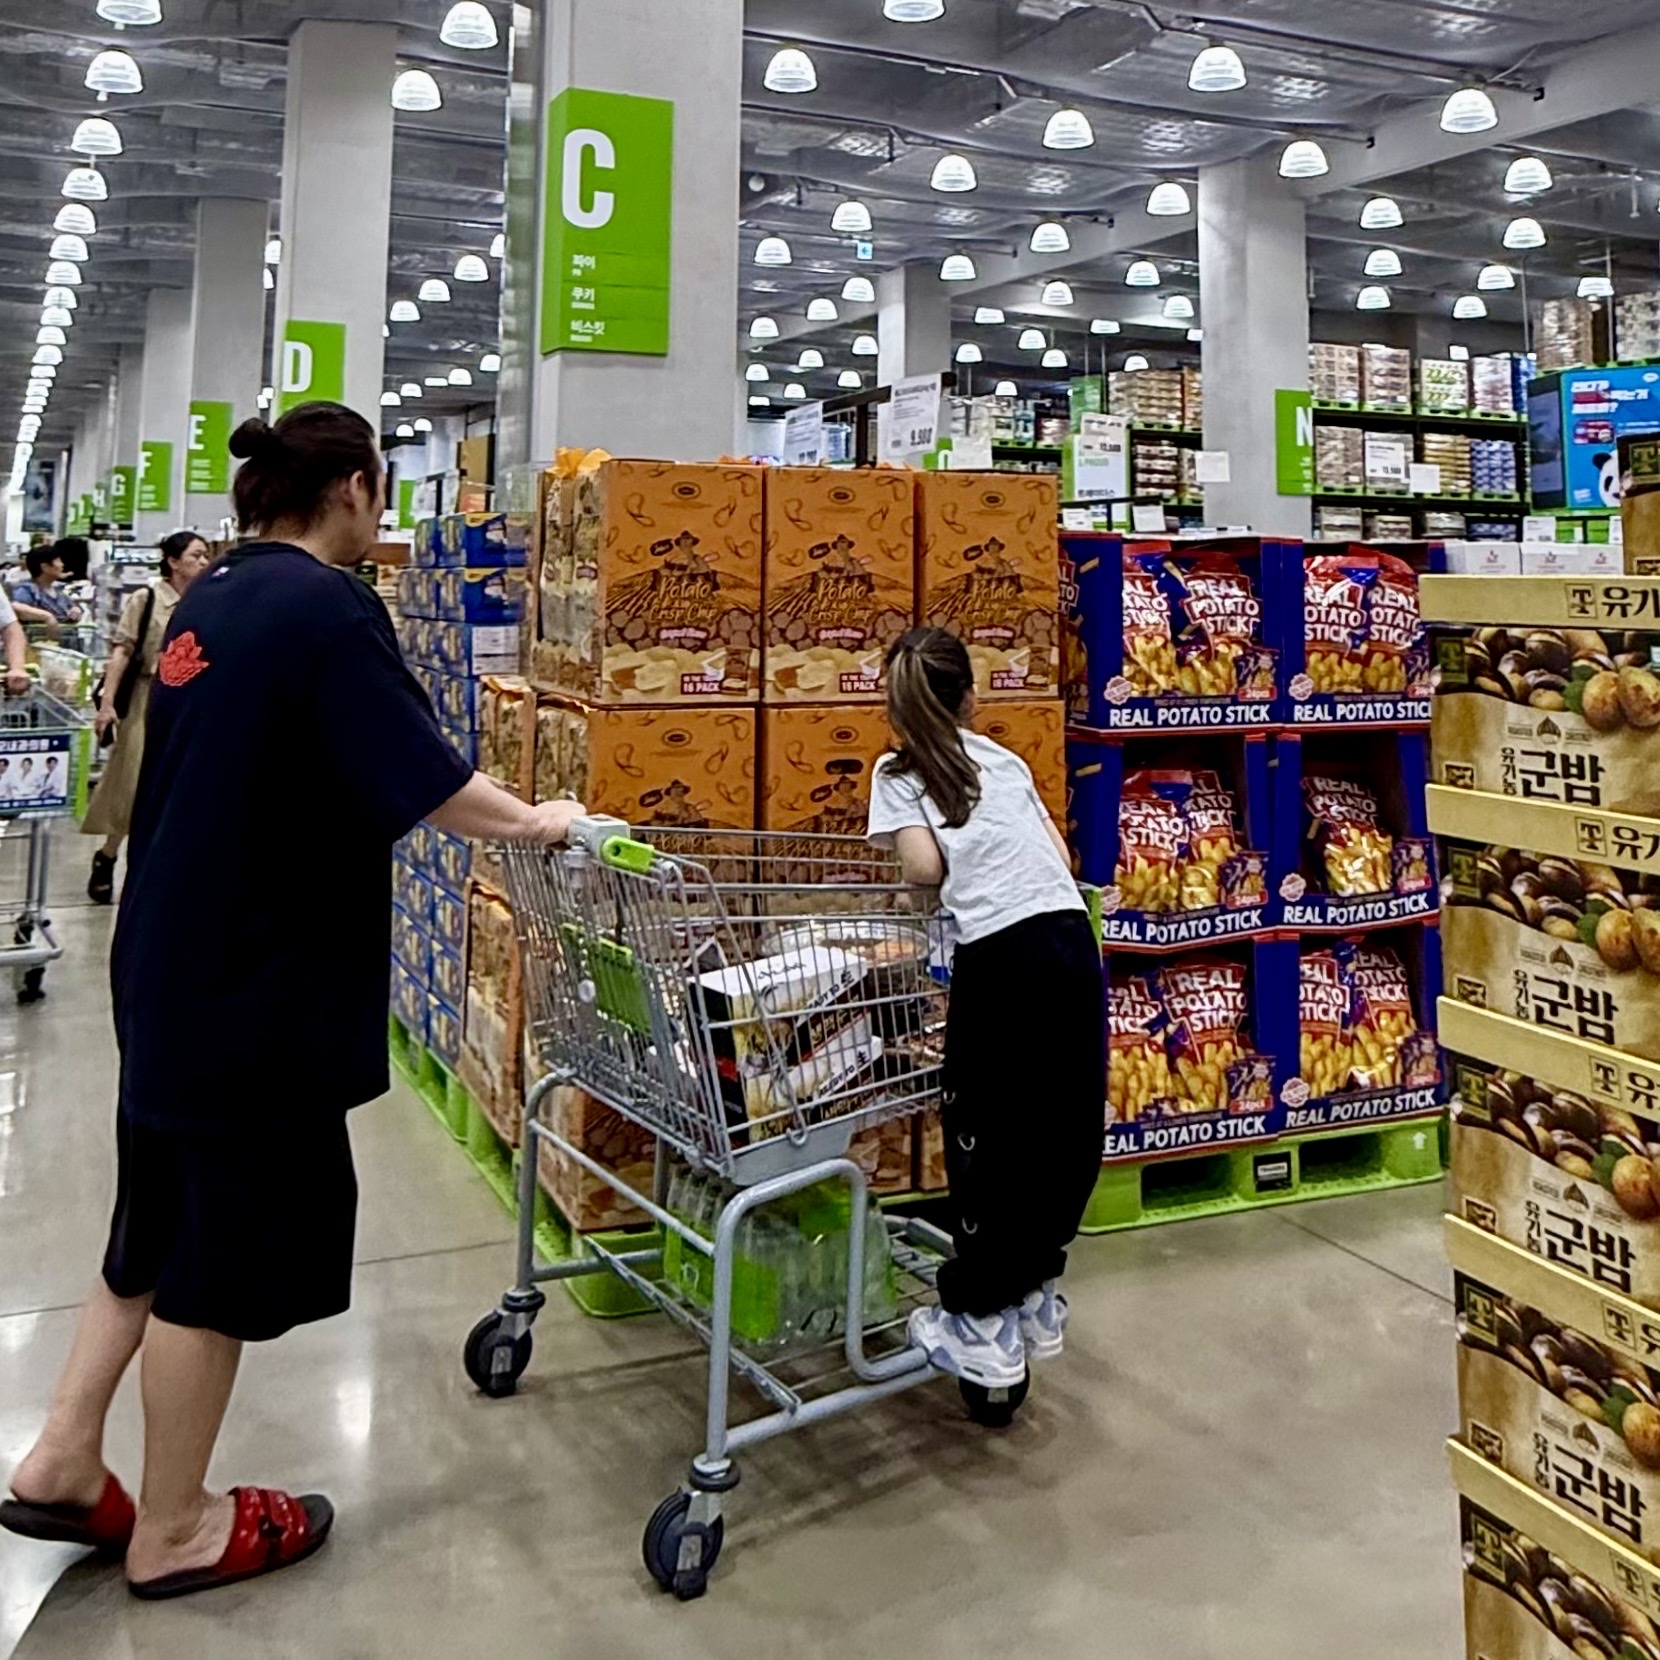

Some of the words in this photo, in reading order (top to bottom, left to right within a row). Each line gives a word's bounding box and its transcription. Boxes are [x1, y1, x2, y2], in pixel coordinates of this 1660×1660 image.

[562, 128, 615, 229] C
[571, 287, 595, 301] 쿠키
[282, 341, 312, 392] D
[188, 415, 206, 450] E
[1296, 406, 1314, 446] N
[138, 451, 153, 478] F
[112, 474, 126, 496] G
[659, 574, 711, 599] Potato
[818, 578, 866, 600] Potato
[1187, 579, 1247, 596] REAL
[1191, 597, 1259, 618] POTATO
[1371, 586, 1419, 614] REAL
[1206, 615, 1249, 634] STICK
[1304, 605, 1361, 627] OTATO
[1370, 607, 1420, 632] OTATO
[1304, 623, 1351, 643] STICK
[1110, 708, 1153, 726] REAL
[1157, 707, 1222, 726] POTATO
[1225, 705, 1270, 724] STICK
[1294, 704, 1333, 721] REAL
[1337, 703, 1394, 720] POTATO
[1313, 776, 1365, 795] REAL
[1519, 749, 1606, 807] 군밤
[1312, 793, 1376, 812] POTATO
[1127, 827, 1174, 851] STICK
[1283, 906, 1323, 924] REAL
[1327, 903, 1386, 924] POTATO
[1389, 893, 1429, 916] STICK
[1145, 919, 1211, 943] POTATO
[1215, 909, 1262, 933] STICK
[1175, 969, 1240, 992] REAL
[1354, 966, 1407, 985] OTATO
[1171, 991, 1247, 1015] POTATO
[1532, 974, 1618, 1044] 군밤
[1108, 1016, 1151, 1036] TICK
[1189, 1010, 1240, 1032] STICK
[1286, 1108, 1326, 1128] REAL
[1330, 1098, 1391, 1122] POTATO
[1395, 1088, 1436, 1112] STICK
[1103, 1134, 1139, 1155] EAL
[1144, 1125, 1212, 1149] POTATO
[1216, 1116, 1266, 1138] STICK
[1545, 1209, 1635, 1293] 군밤
[1552, 1444, 1646, 1543] 군밤
